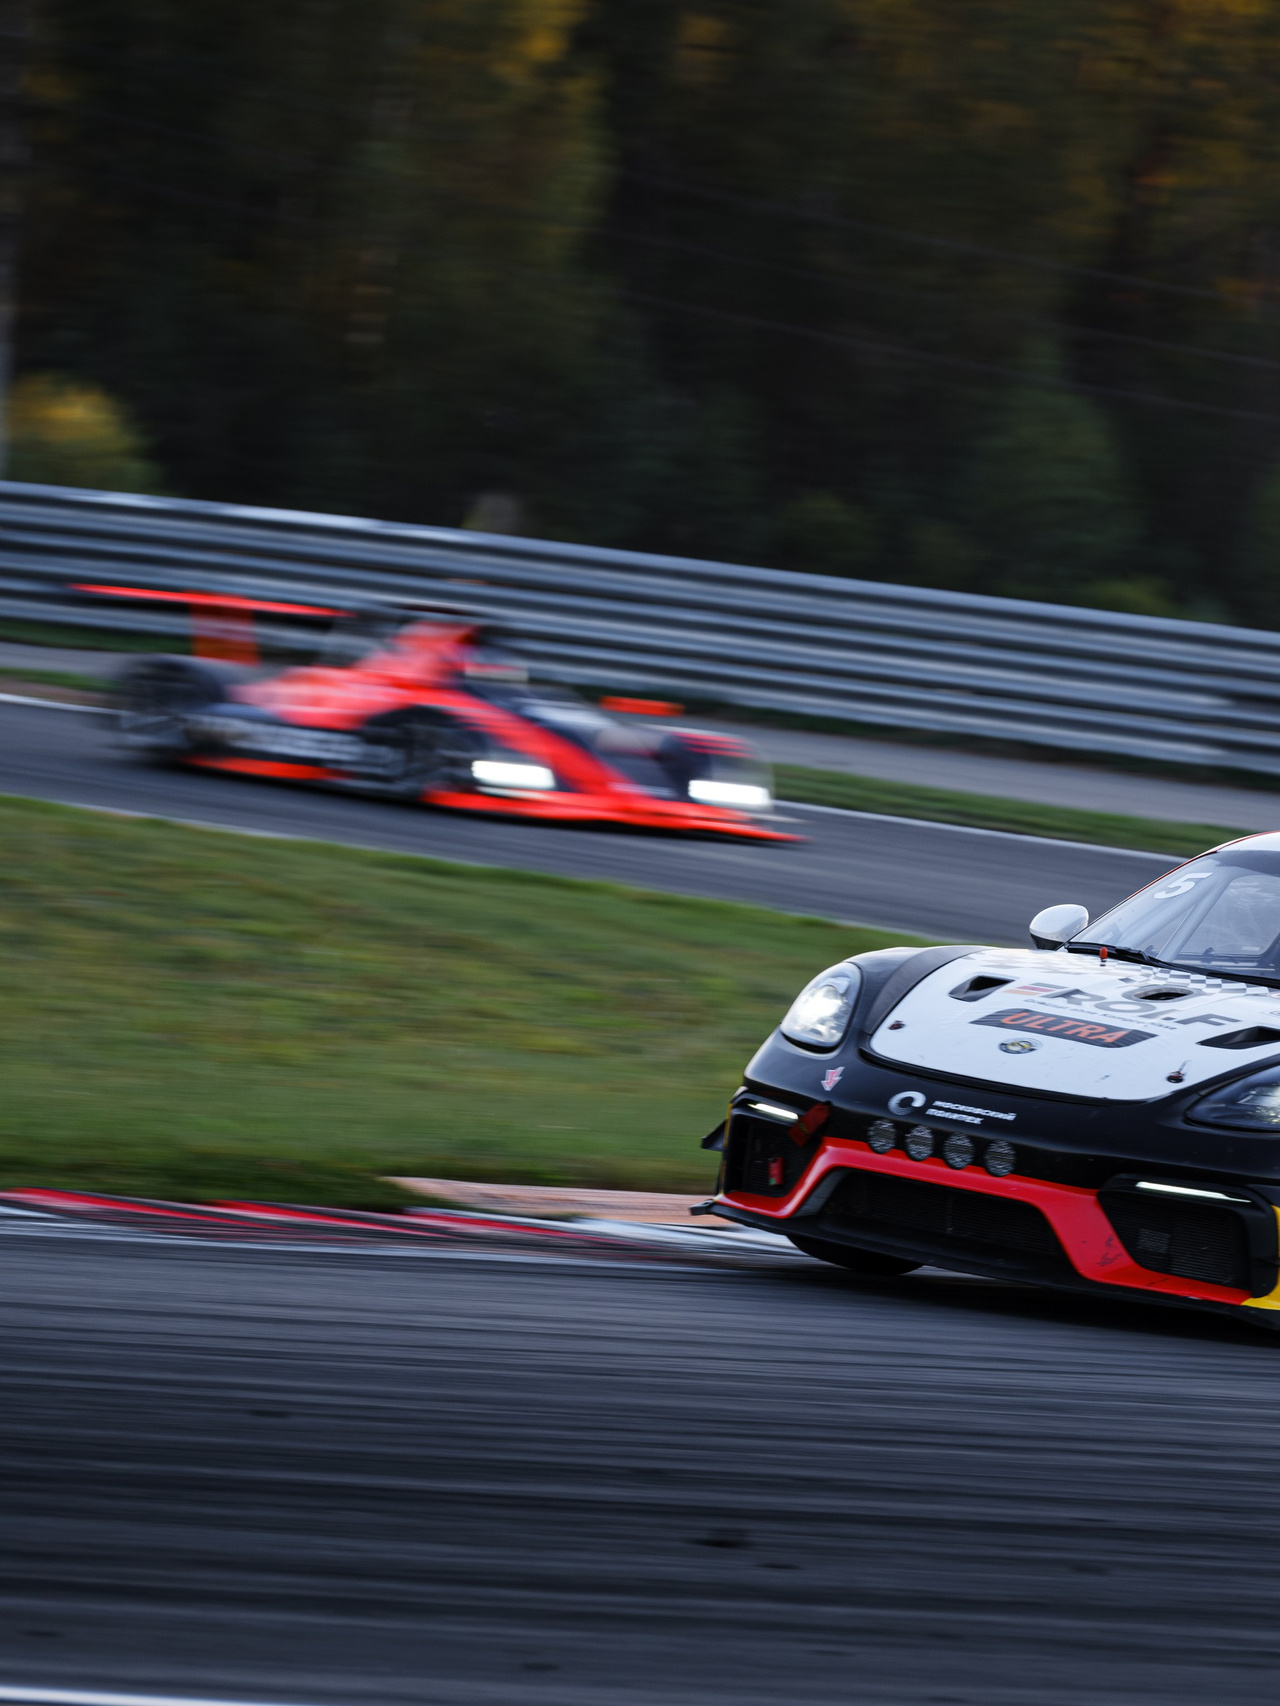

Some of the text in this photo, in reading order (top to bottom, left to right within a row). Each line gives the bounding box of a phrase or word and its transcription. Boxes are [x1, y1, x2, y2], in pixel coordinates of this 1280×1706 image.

[1153, 872, 1214, 899] 5
[1043, 988, 1243, 1026] ROLF
[1001, 1012, 1131, 1044] ULTRA
